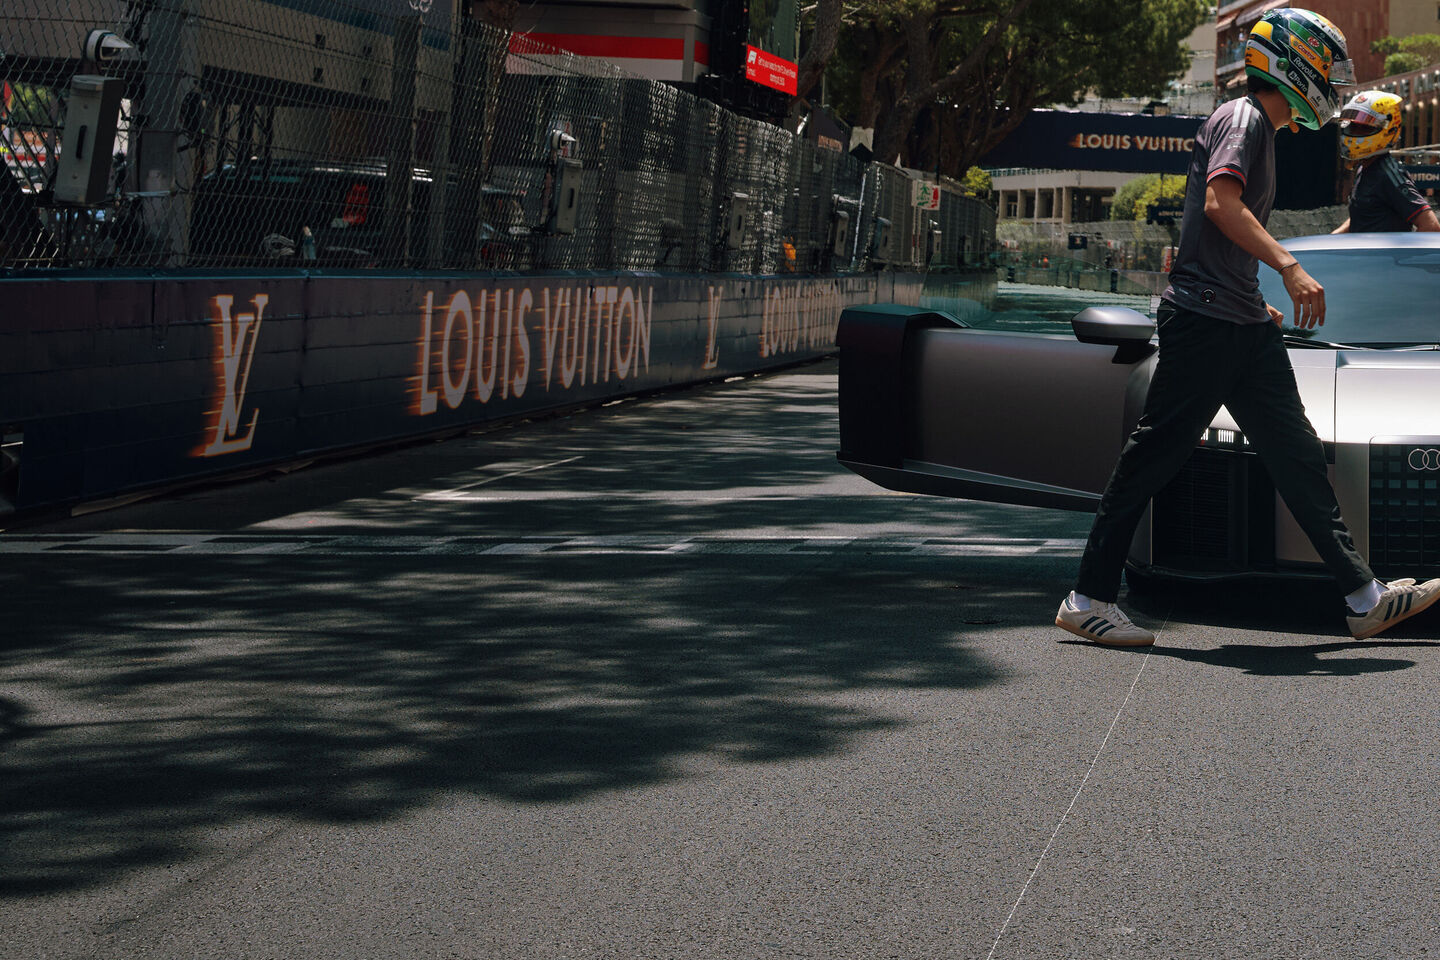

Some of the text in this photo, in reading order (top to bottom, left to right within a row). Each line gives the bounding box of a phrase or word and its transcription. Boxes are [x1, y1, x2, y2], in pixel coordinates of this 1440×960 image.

[1293, 57, 1318, 81] Revolut
[1077, 133, 1195, 152] LOUIS VUITTO
[415, 285, 654, 416] LOUIS VUITTON
